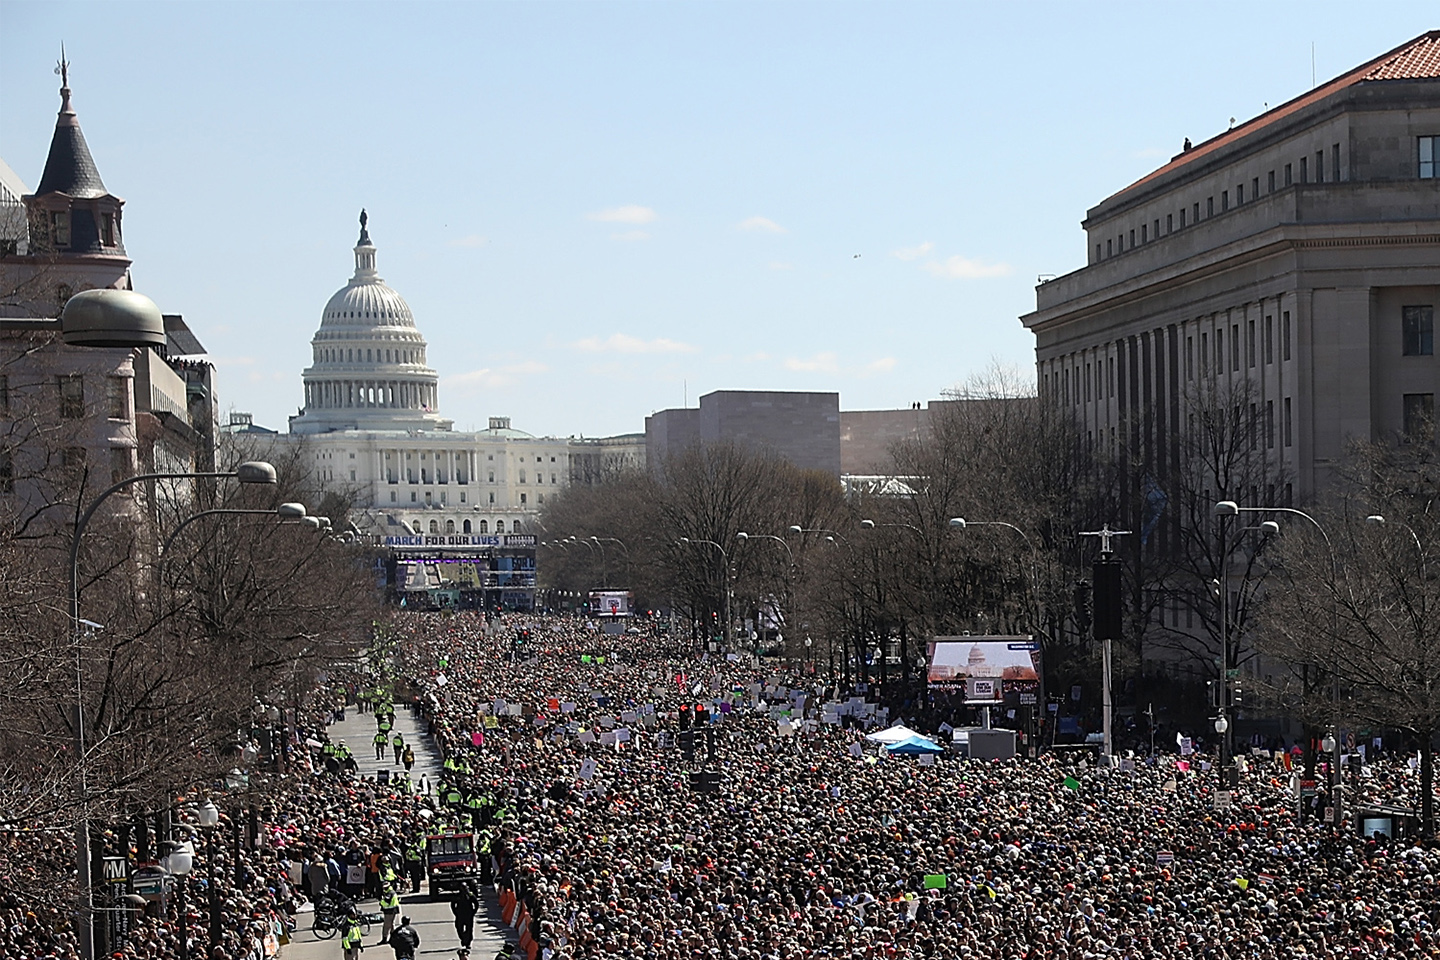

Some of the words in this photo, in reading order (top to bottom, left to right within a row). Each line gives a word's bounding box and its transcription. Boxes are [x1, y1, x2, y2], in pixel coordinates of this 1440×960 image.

[386, 535, 422, 546] MARCH
[425, 536, 446, 546] FOR
[448, 536, 469, 545] OUR
[471, 536, 500, 546] LIVES
[111, 860, 126, 879] M
